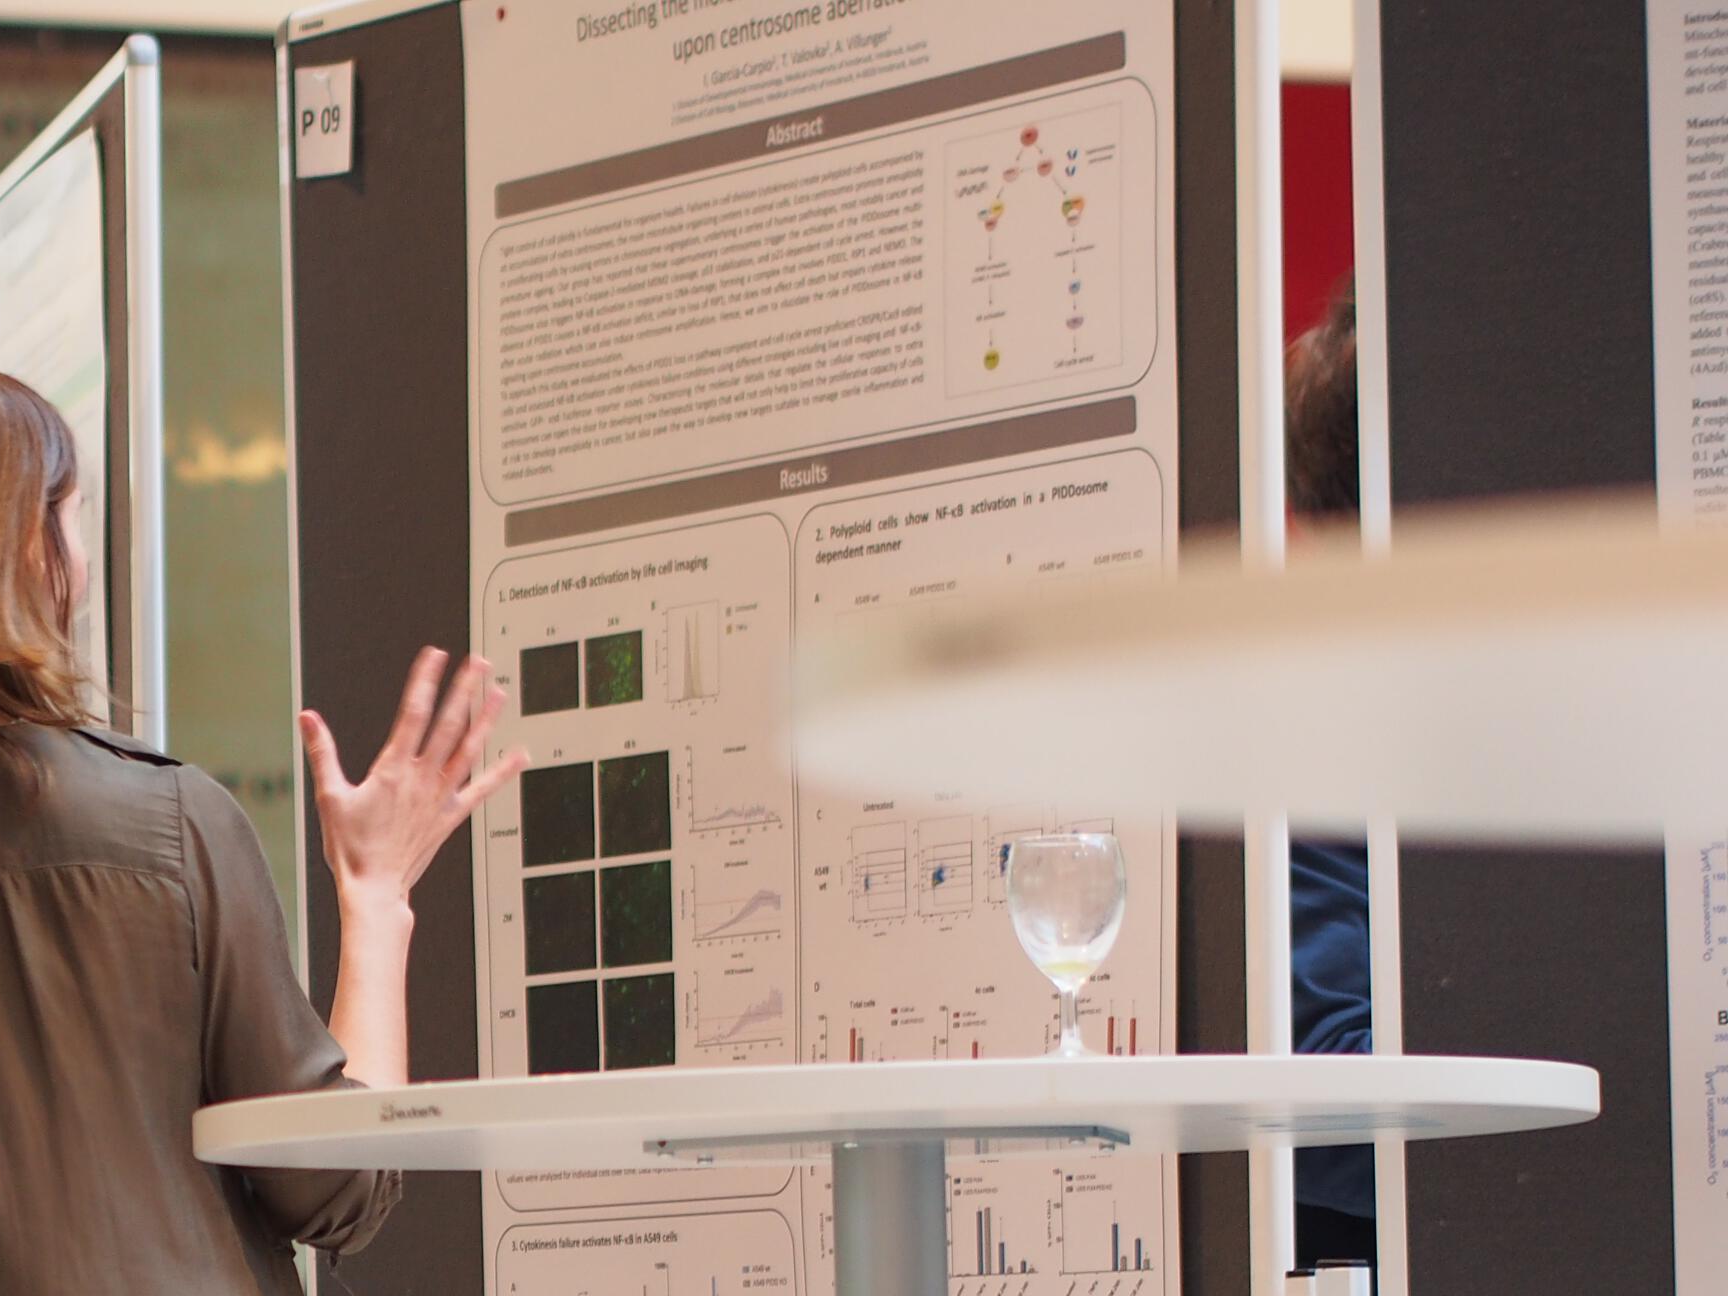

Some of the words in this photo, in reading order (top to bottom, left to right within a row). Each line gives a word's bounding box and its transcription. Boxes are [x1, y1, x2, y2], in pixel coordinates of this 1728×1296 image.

[576, 2, 658, 42] Dissecting
[661, 0, 689, 18] the
[673, 32, 714, 63] upon
[720, 5, 822, 48] centrosome
[301, 110, 315, 137] P
[321, 105, 340, 134] 09
[766, 116, 823, 148] Abstract
[780, 463, 828, 491] Results
[816, 529, 823, 542] 2.
[830, 518, 872, 540] Polyploid
[878, 514, 898, 531] cells
[904, 510, 929, 527] show
[970, 496, 1017, 516] activation
[1023, 492, 1032, 504] in
[1039, 494, 1045, 503] a
[1052, 480, 1109, 500] PIDDosome
[815, 543, 864, 565] dependent
[866, 539, 902, 556] manner
[499, 591, 506, 603] 1.
[510, 580, 549, 601] Detection
[551, 579, 560, 594] of
[589, 568, 630, 588] activation
[631, 567, 641, 583] by
[643, 564, 657, 579] life
[658, 561, 673, 576] cell
[675, 556, 709, 576] imaging
[1718, 1010, 1728, 1026] B
[520, 1237, 558, 1254] Cytokinesis
[559, 1235, 581, 1251] failure
[582, 1234, 612, 1249] activates
[635, 1232, 642, 1244] in
[643, 1232, 661, 1244] A549
[663, 1231, 678, 1244] cells
